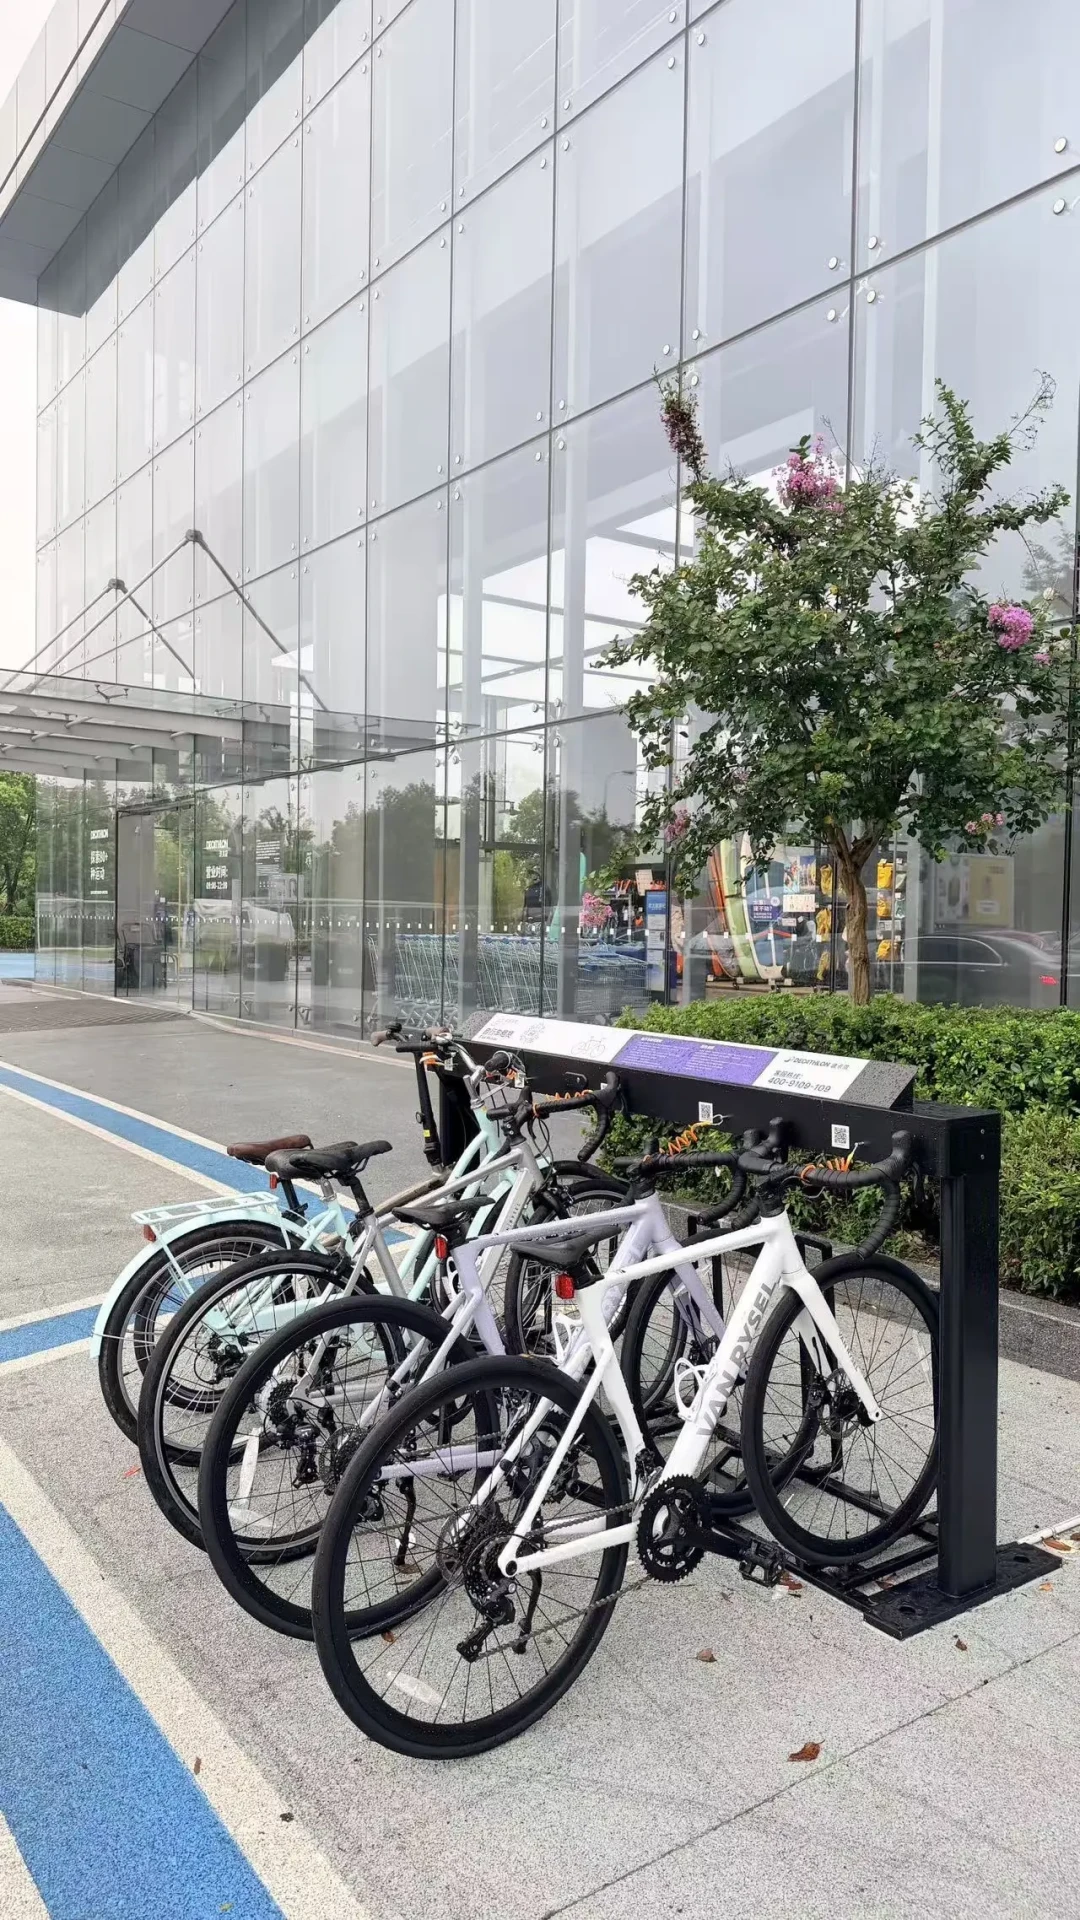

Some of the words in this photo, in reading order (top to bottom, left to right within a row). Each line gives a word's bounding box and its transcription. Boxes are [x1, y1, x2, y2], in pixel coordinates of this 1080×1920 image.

[794, 1057, 831, 1067] DECATHLON
[768, 1076, 832, 1093] 400-9109-109
[696, 1369, 736, 1436] VAN
[729, 1282, 777, 1367] RYSEL
